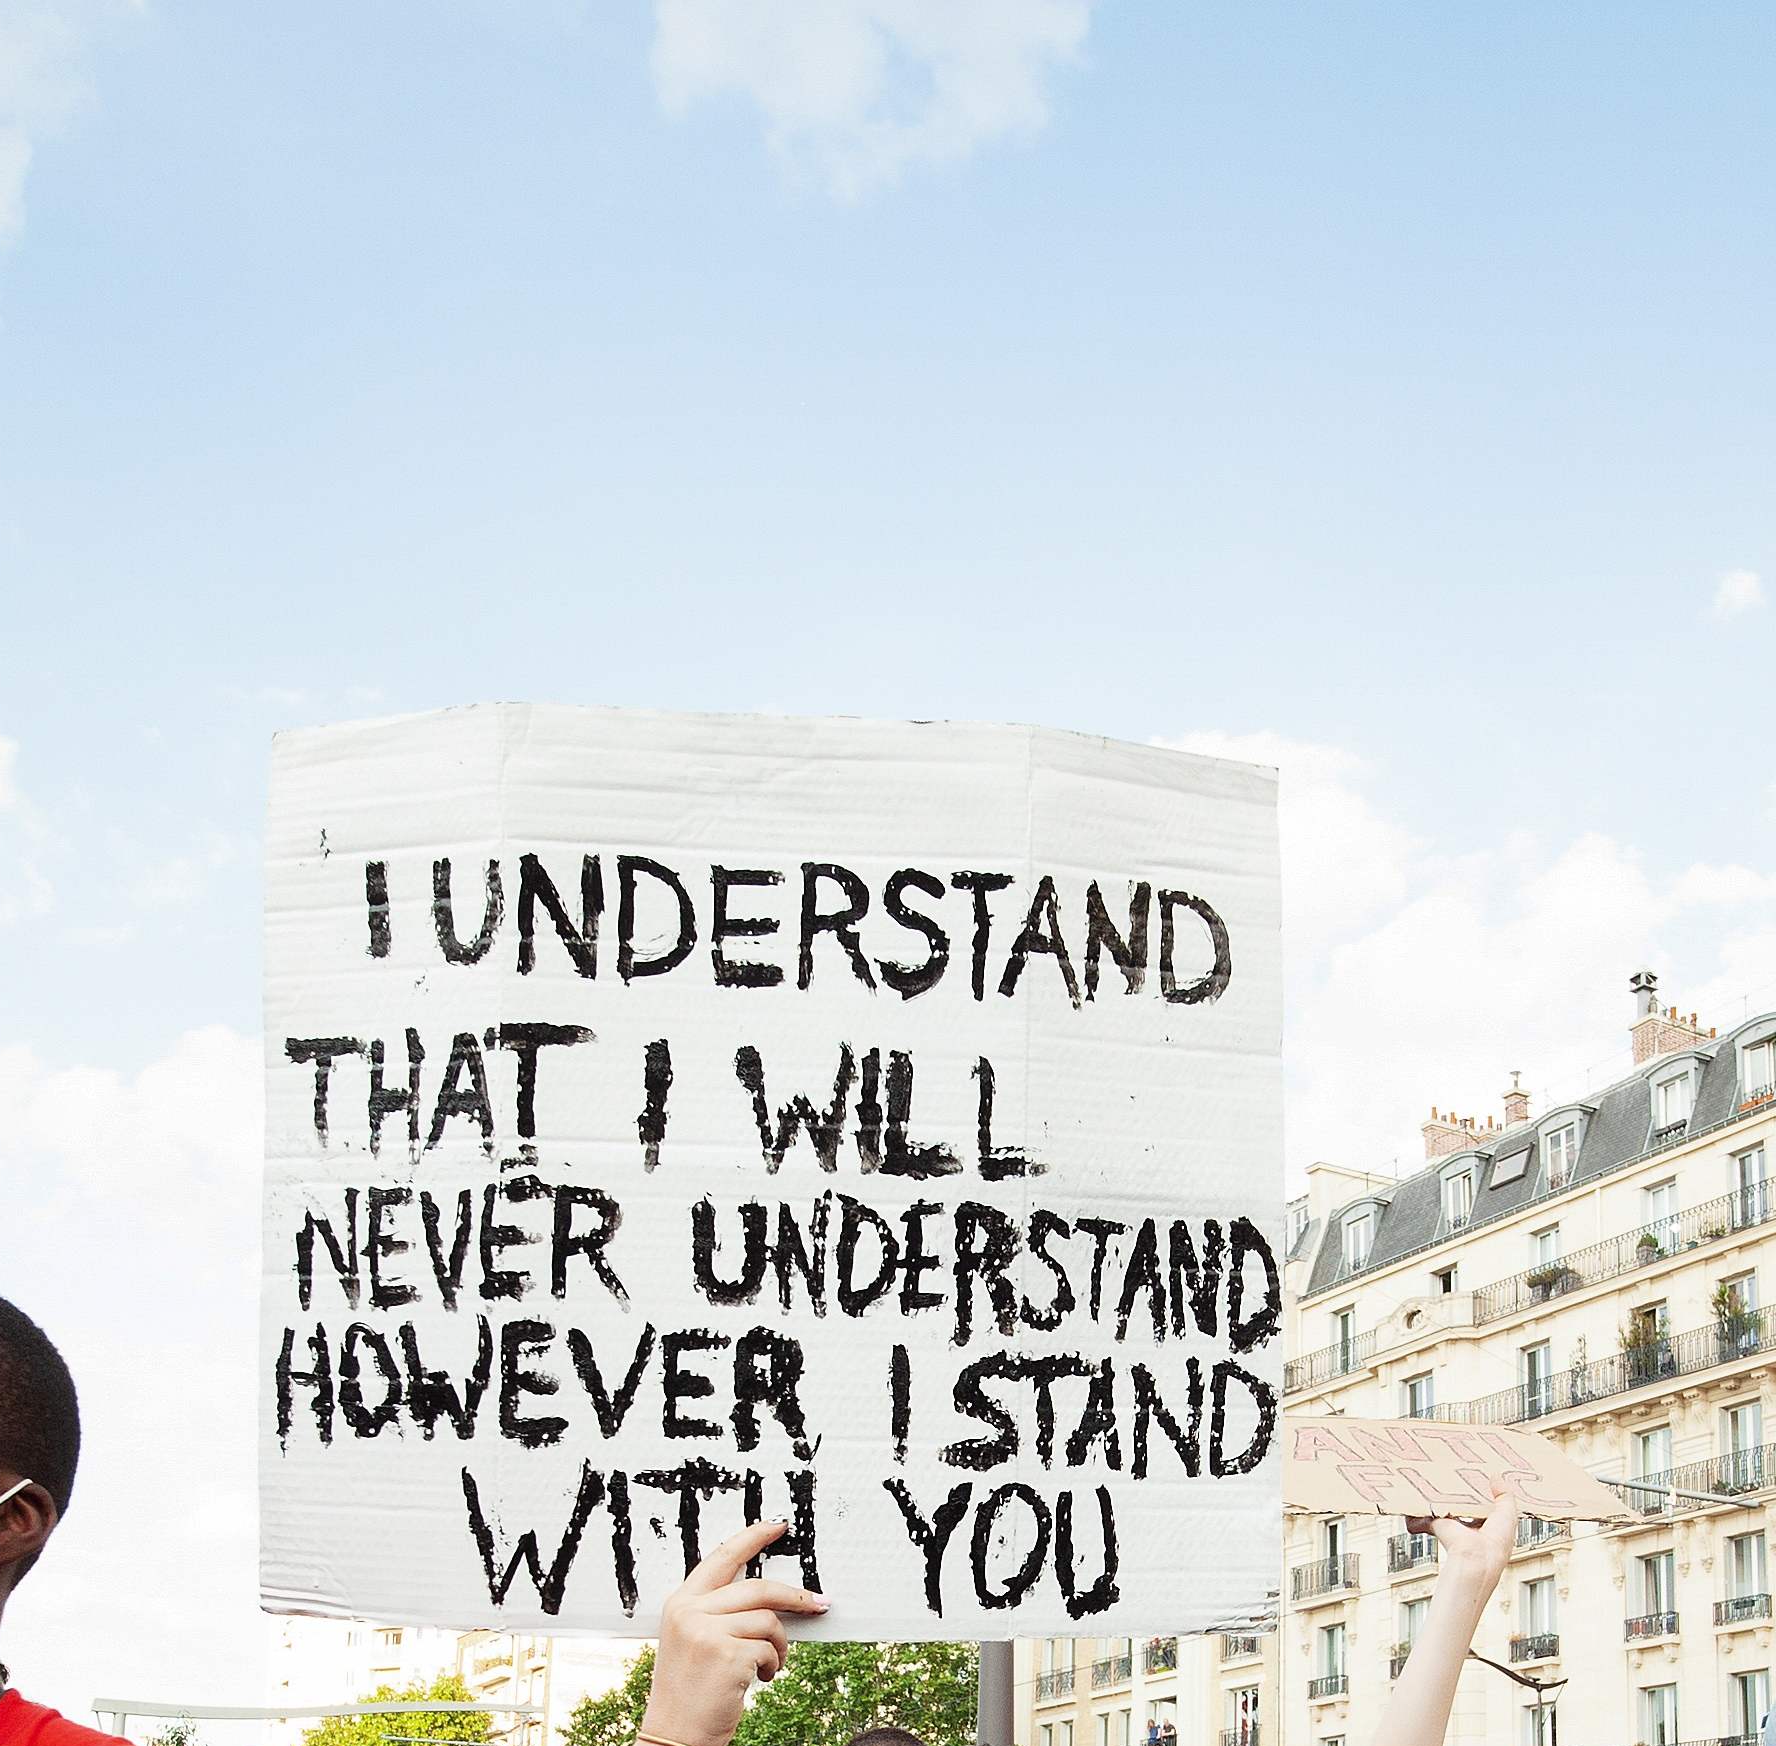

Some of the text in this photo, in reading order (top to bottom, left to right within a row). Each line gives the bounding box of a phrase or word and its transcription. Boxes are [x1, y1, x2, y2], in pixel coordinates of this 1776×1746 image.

[366, 853, 1232, 1010] I UNDERSTAND
[284, 1022, 1047, 1182] THAT I WILL
[292, 1175, 1283, 1356] NEVER UNDERSTAND
[887, 1343, 912, 1466] I
[938, 1348, 1280, 1480] STAND
[1293, 1426, 1534, 1470] ANTI
[462, 1455, 1122, 1621] WITH YOU
